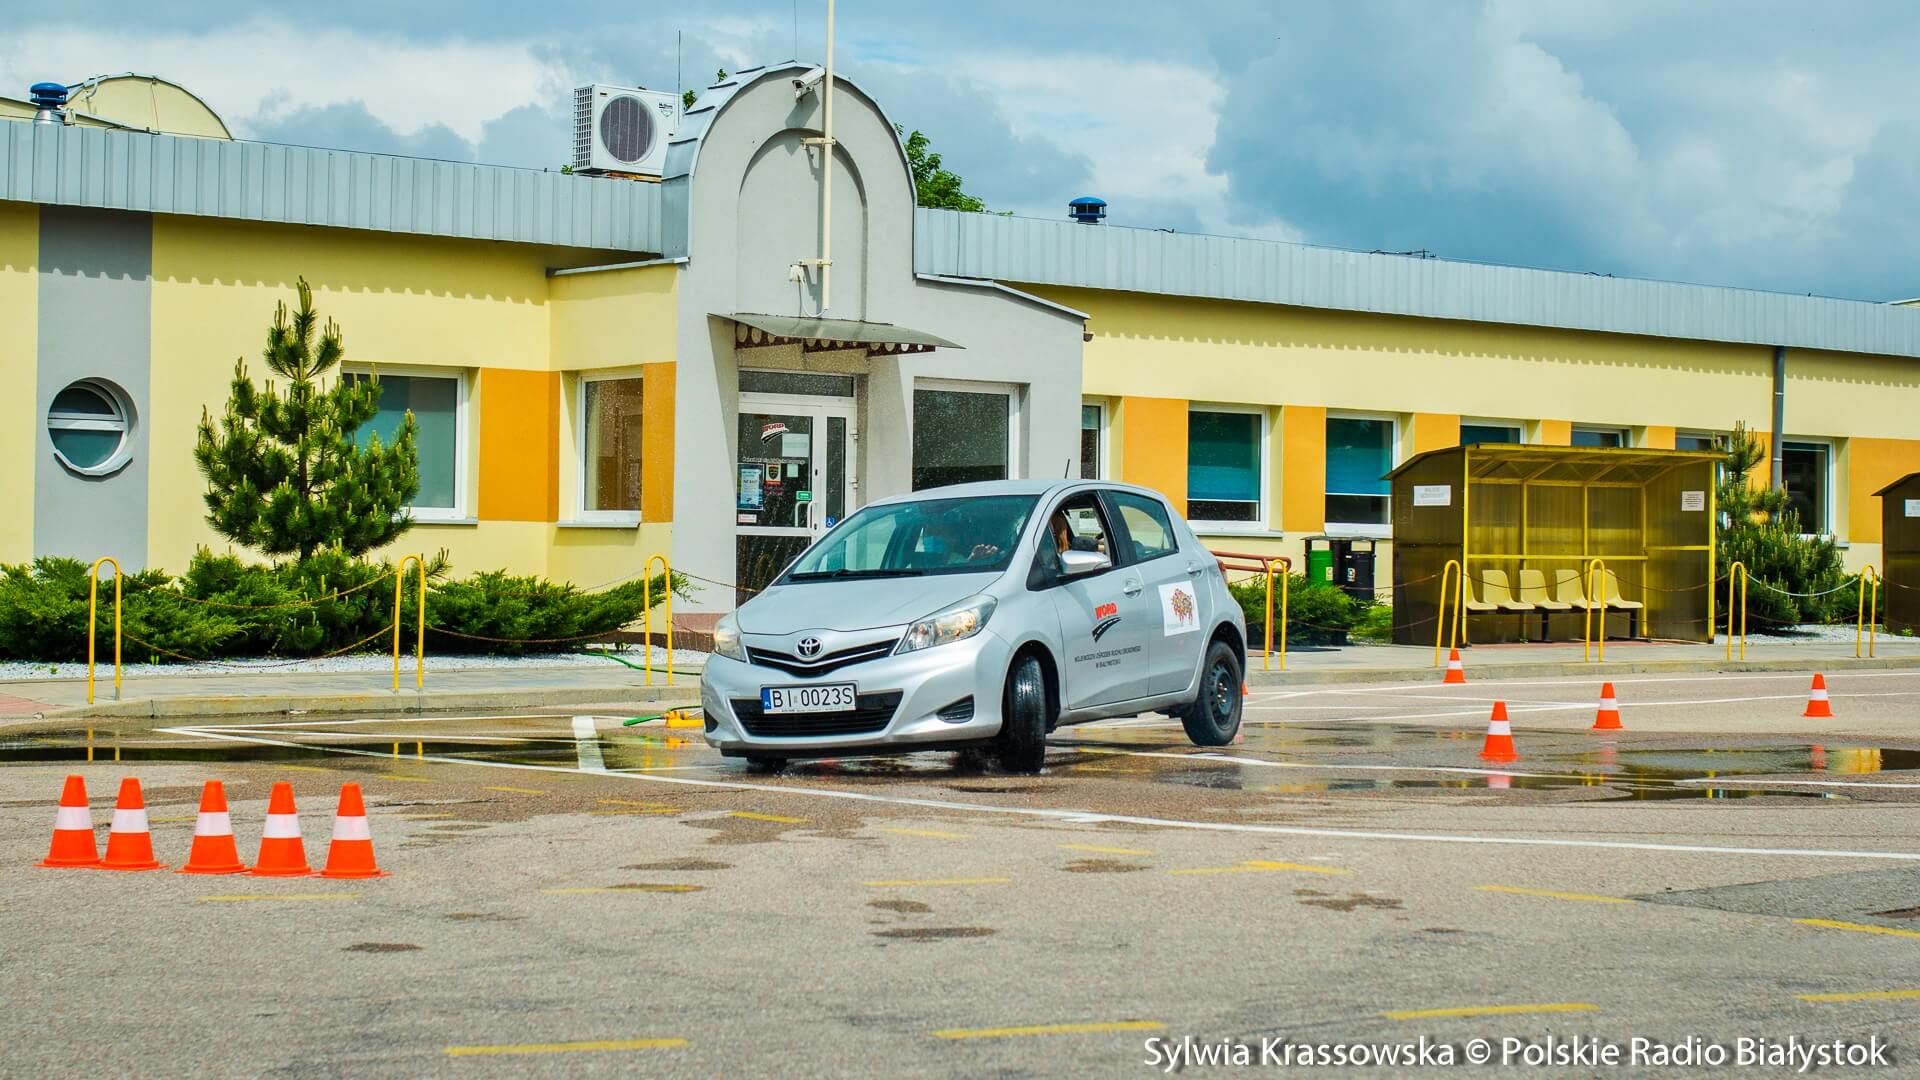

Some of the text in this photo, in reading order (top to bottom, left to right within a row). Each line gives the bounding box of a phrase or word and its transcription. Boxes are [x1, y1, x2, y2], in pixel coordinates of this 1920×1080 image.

[1095, 602, 1117, 620] WORD
[772, 687, 853, 707] BI 0023S
